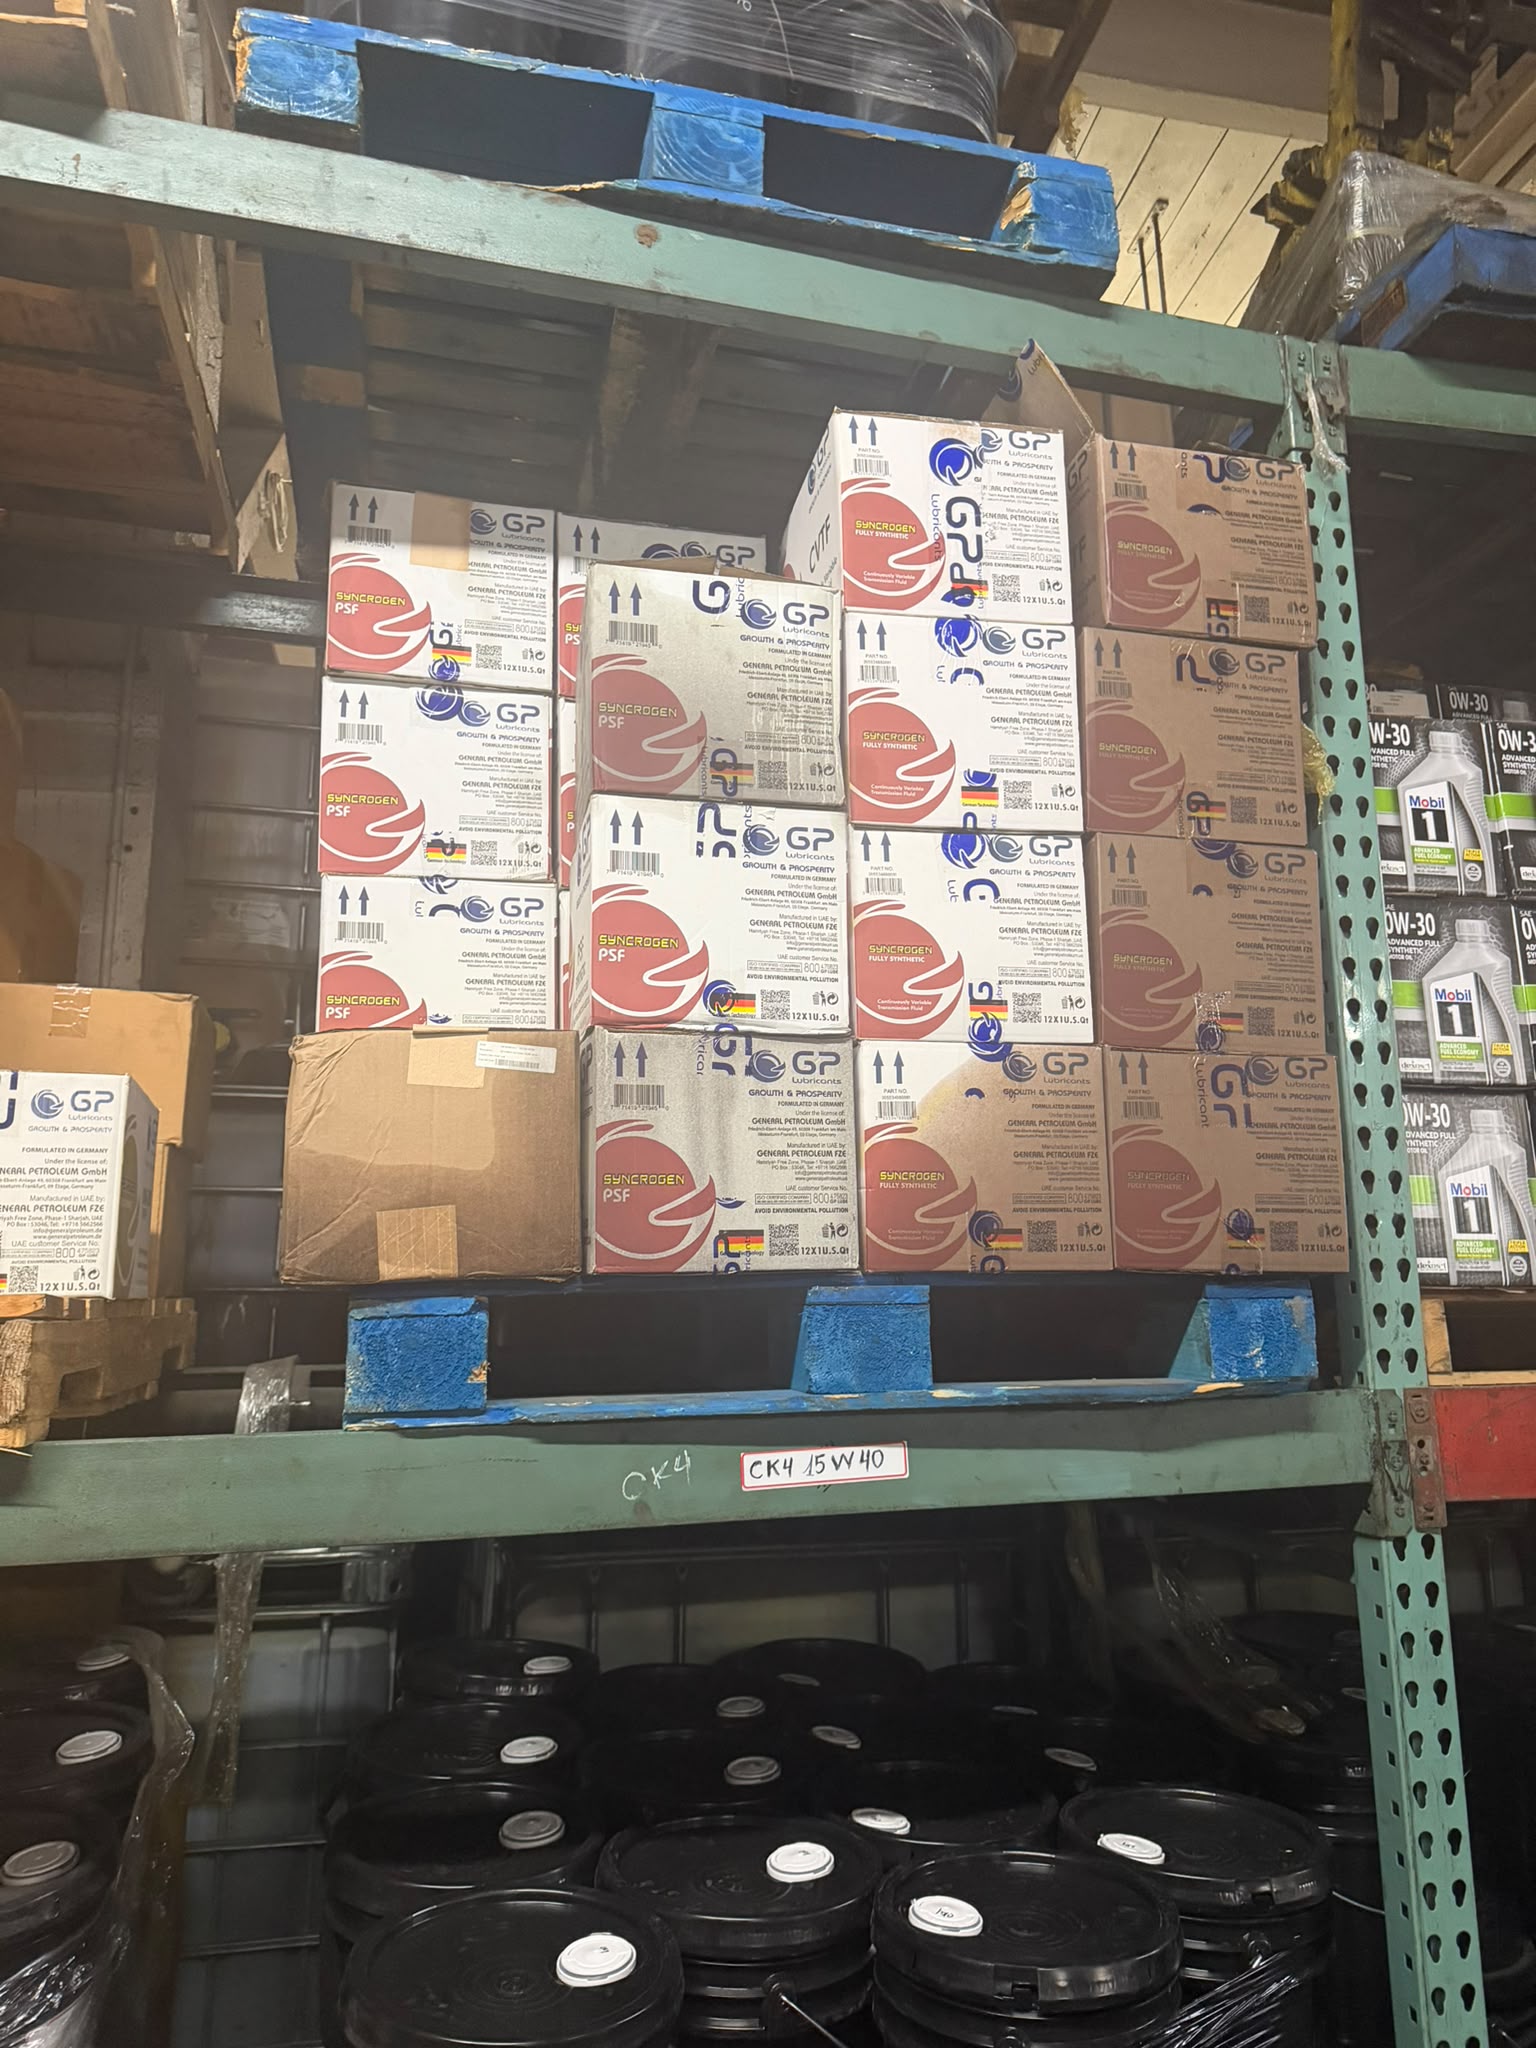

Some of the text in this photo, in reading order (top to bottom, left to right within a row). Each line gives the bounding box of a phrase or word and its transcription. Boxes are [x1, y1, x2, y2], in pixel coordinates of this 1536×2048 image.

[1009, 430, 1050, 450] GP
[1008, 450, 1053, 460] Lubricants
[1256, 459, 1295, 481] GP
[503, 513, 545, 534] GP
[854, 520, 916, 533] SYNCROGEN
[946, 496, 984, 564] GP
[502, 533, 545, 542] Lubricants
[876, 531, 909, 539] SYNTHETIC
[809, 513, 830, 574] CVTF
[1117, 540, 1173, 555] SYNCROGEN
[716, 545, 755, 565] GP
[335, 591, 406, 606] SYNCROGEN
[335, 602, 359, 615] PSF
[783, 602, 830, 627] GP
[783, 626, 830, 638] Lubricants
[740, 634, 774, 645] GROWTH
[786, 638, 830, 650] PROSPERITY
[1022, 628, 1066, 650] GP
[1022, 650, 1068, 659] Lubricants
[1026, 662, 1068, 671] PROSPERITY
[1245, 652, 1286, 674] GP
[1449, 690, 1488, 712] 0W-30
[496, 703, 540, 724] GP
[598, 702, 677, 718] SYNCROGEN
[496, 724, 540, 732] Lubricants
[598, 715, 625, 729] PSF
[457, 731, 488, 739] GROWTH
[499, 734, 541, 743] PROSPERITY
[862, 731, 925, 742] SYNCROGEN
[883, 743, 918, 751] SYNTHETIC
[1099, 742, 1157, 755] SYNCROGEN
[458, 754, 542, 765] GENERAL PETROLEUM GmbH
[326, 793, 399, 805] SYNCROGEN
[1409, 795, 1445, 809] Mobil
[326, 805, 351, 817] PSF
[1421, 811, 1436, 840] 1
[786, 826, 834, 851] GP
[1029, 836, 1073, 857] GP
[785, 852, 834, 861] Lubricants
[1028, 858, 1075, 866] Lubricants
[742, 861, 777, 870] GROWTH
[788, 864, 835, 873] PROSPERITY
[1264, 852, 1306, 875] GP
[989, 868, 1022, 876] GROWTH
[1033, 869, 1076, 878] PROSPERITY
[745, 888, 837, 900] GENERAL PETROLEUM GmbH
[500, 897, 544, 918] GP
[500, 918, 544, 926] Lubricants
[750, 919, 838, 930] GENERAL PETROLEUM FZE
[1386, 911, 1436, 937] 0W-30
[598, 934, 679, 949] SYNCROGEN
[598, 949, 625, 962] PSF
[868, 945, 933, 955] SYNCROGEN
[889, 955, 925, 963] SYNTHETIC
[1113, 953, 1173, 966] SYNCROGEN
[804, 963, 820, 973] 800
[764, 974, 809, 982] ENVIRONMENTAL
[325, 995, 400, 1006] SYNCROGEN
[1434, 988, 1472, 1001] Mobil
[325, 1007, 351, 1019] PSF
[1447, 1004, 1463, 1035] 1
[792, 1050, 841, 1076] GP
[1043, 1052, 1089, 1075] GP
[1285, 1057, 1328, 1080] GP
[792, 1077, 842, 1085] Lubricants
[1043, 1077, 1090, 1085] Lubricants
[748, 1089, 783, 1097] GROWTH
[796, 1090, 843, 1098] PROSPERITY
[70, 1090, 114, 1113] GP
[68, 1114, 113, 1122] Lubricants
[752, 1118, 846, 1126] GENERAL PETROLEUM GmbH
[757, 1150, 847, 1158] GENERAL PETROLEUM FZE
[29, 1167, 78, 1175] PETROLEUM
[81, 1168, 107, 1176] GmbH
[880, 1171, 945, 1181] SYNCROGEN
[603, 1174, 685, 1186] SYNCROGEN
[901, 1182, 937, 1190] SYNTHETIC
[603, 1188, 630, 1202] PSF
[1450, 1183, 1488, 1196] Mobil
[1463, 1200, 1480, 1232] 1
[56, 1247, 76, 1258] 800
[750, 1457, 793, 1479] CK4
[622, 1450, 691, 1500] CK4
